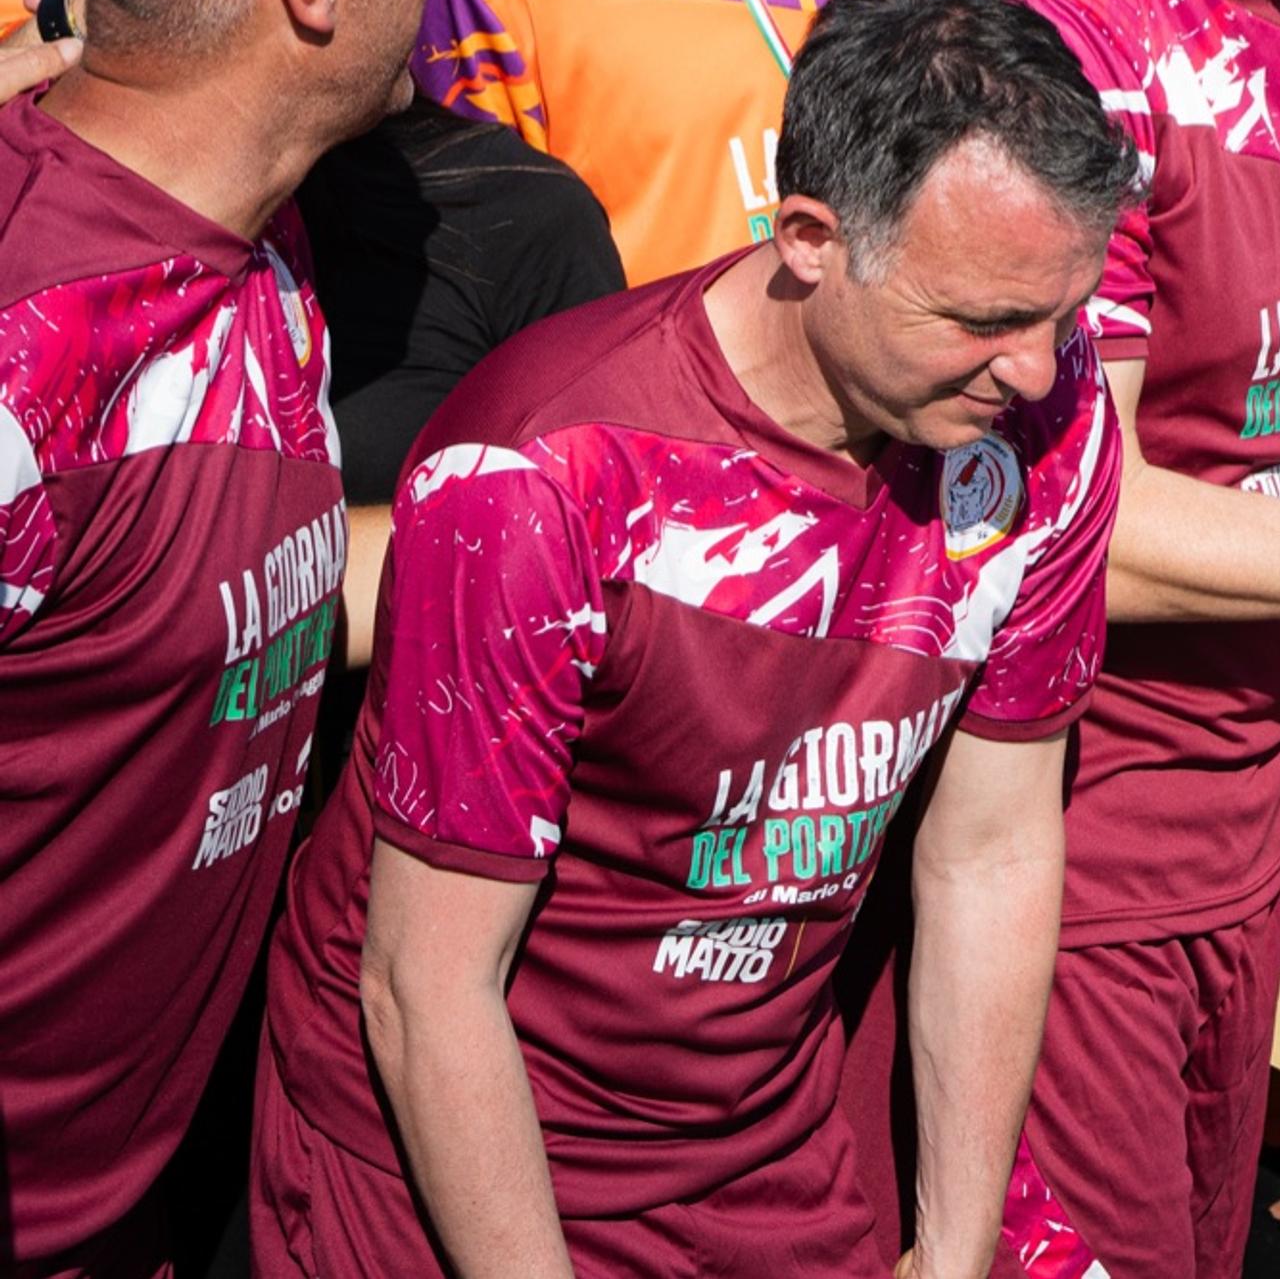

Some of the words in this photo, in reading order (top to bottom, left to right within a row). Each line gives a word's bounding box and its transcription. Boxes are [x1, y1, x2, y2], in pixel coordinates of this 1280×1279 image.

[219, 568, 262, 665] LA
[210, 658, 261, 727] DEL
[206, 763, 269, 834] STUDIO
[700, 759, 766, 829] LA
[192, 801, 262, 871] MATTO
[686, 827, 752, 890] DEL
[771, 882, 839, 904] Mario
[652, 936, 774, 984] MATTO
[666, 916, 788, 951] STUDIO
